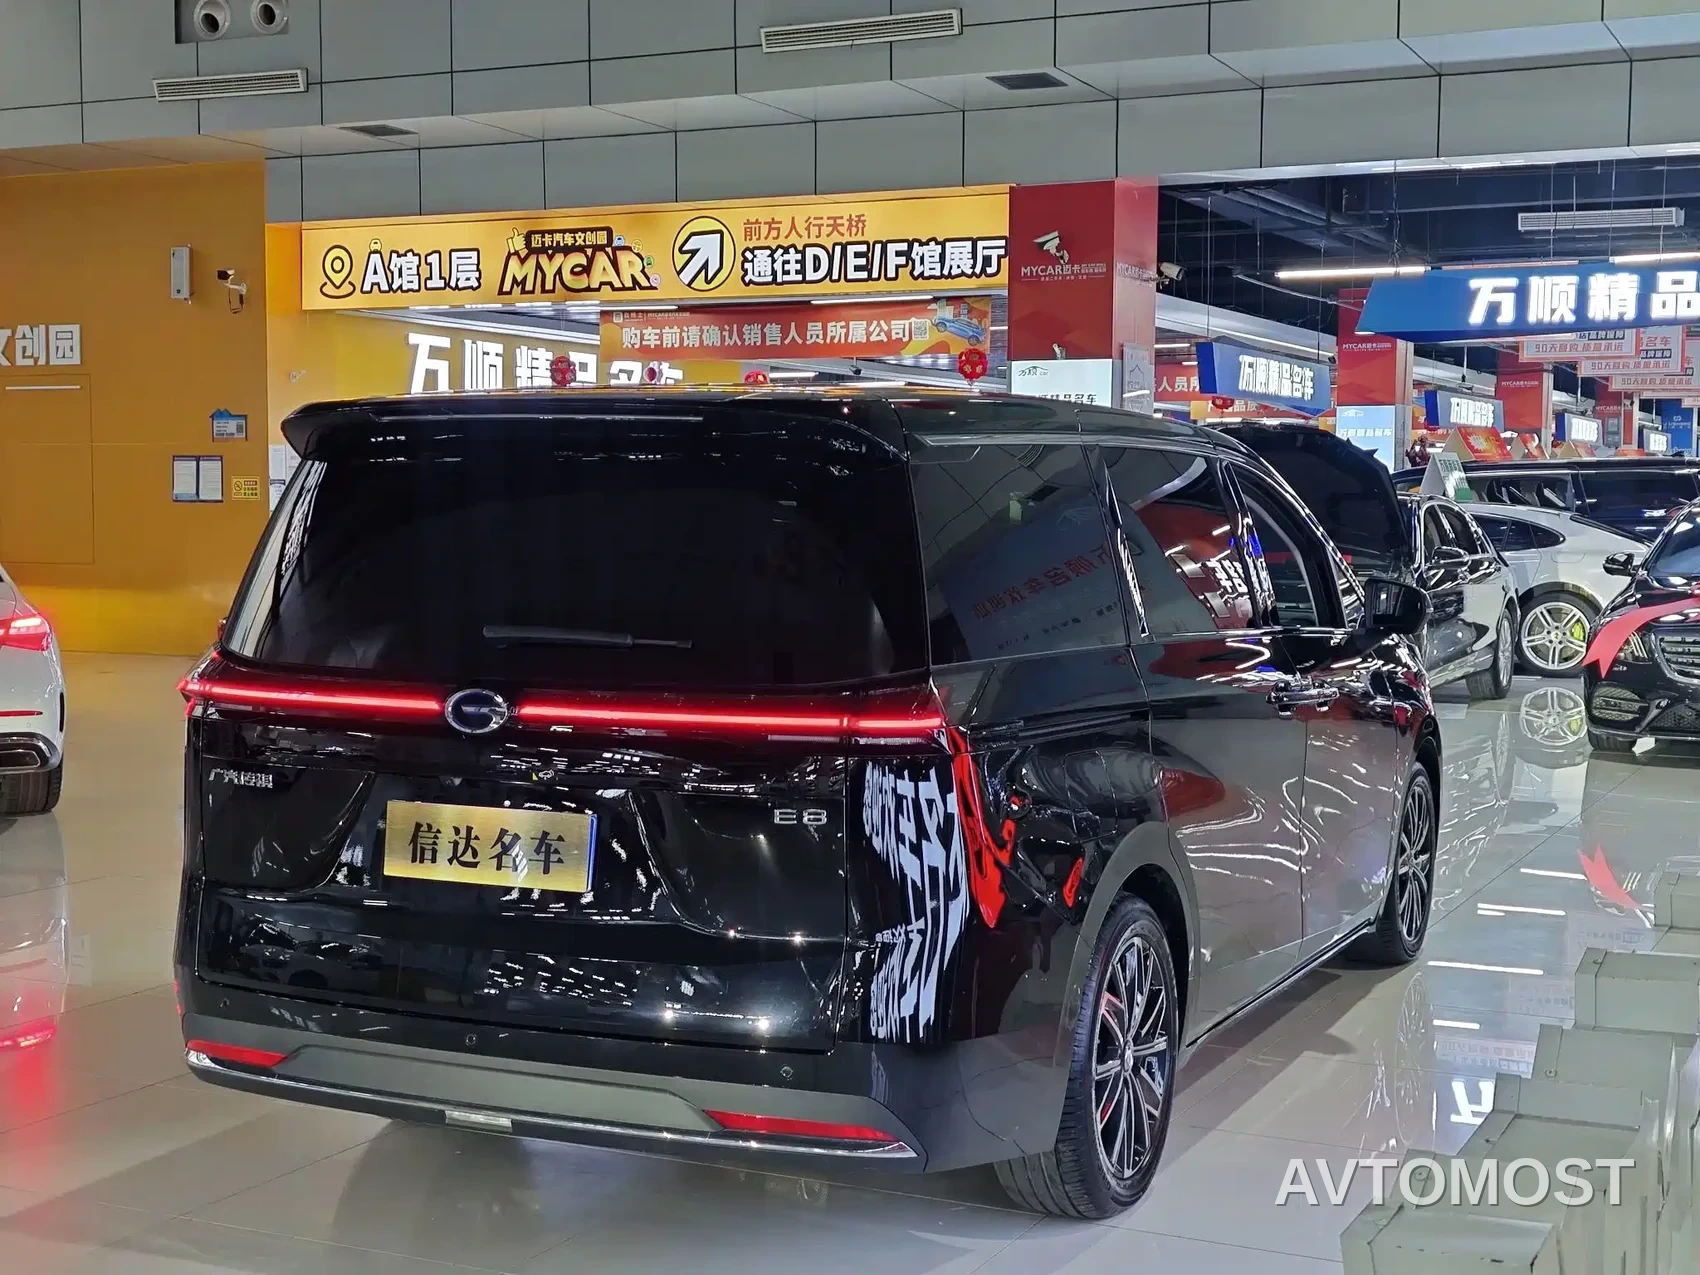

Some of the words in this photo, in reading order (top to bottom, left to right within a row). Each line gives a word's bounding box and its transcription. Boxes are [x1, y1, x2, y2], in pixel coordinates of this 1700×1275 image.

[531, 231, 608, 247] 迈卡汽车文创园
[743, 214, 867, 241] 前方人行天桥
[362, 250, 480, 293] A馆1层
[501, 249, 652, 294] MYCAR
[742, 238, 1008, 285] 通往D/E/F馆展厅
[1468, 270, 1700, 326] 万顺精品
[622, 319, 911, 349] 购车前请确认销售人员所属公司
[1154, 375, 1200, 394] 人员所
[774, 808, 828, 825] E8
[408, 821, 566, 875] 信达名车
